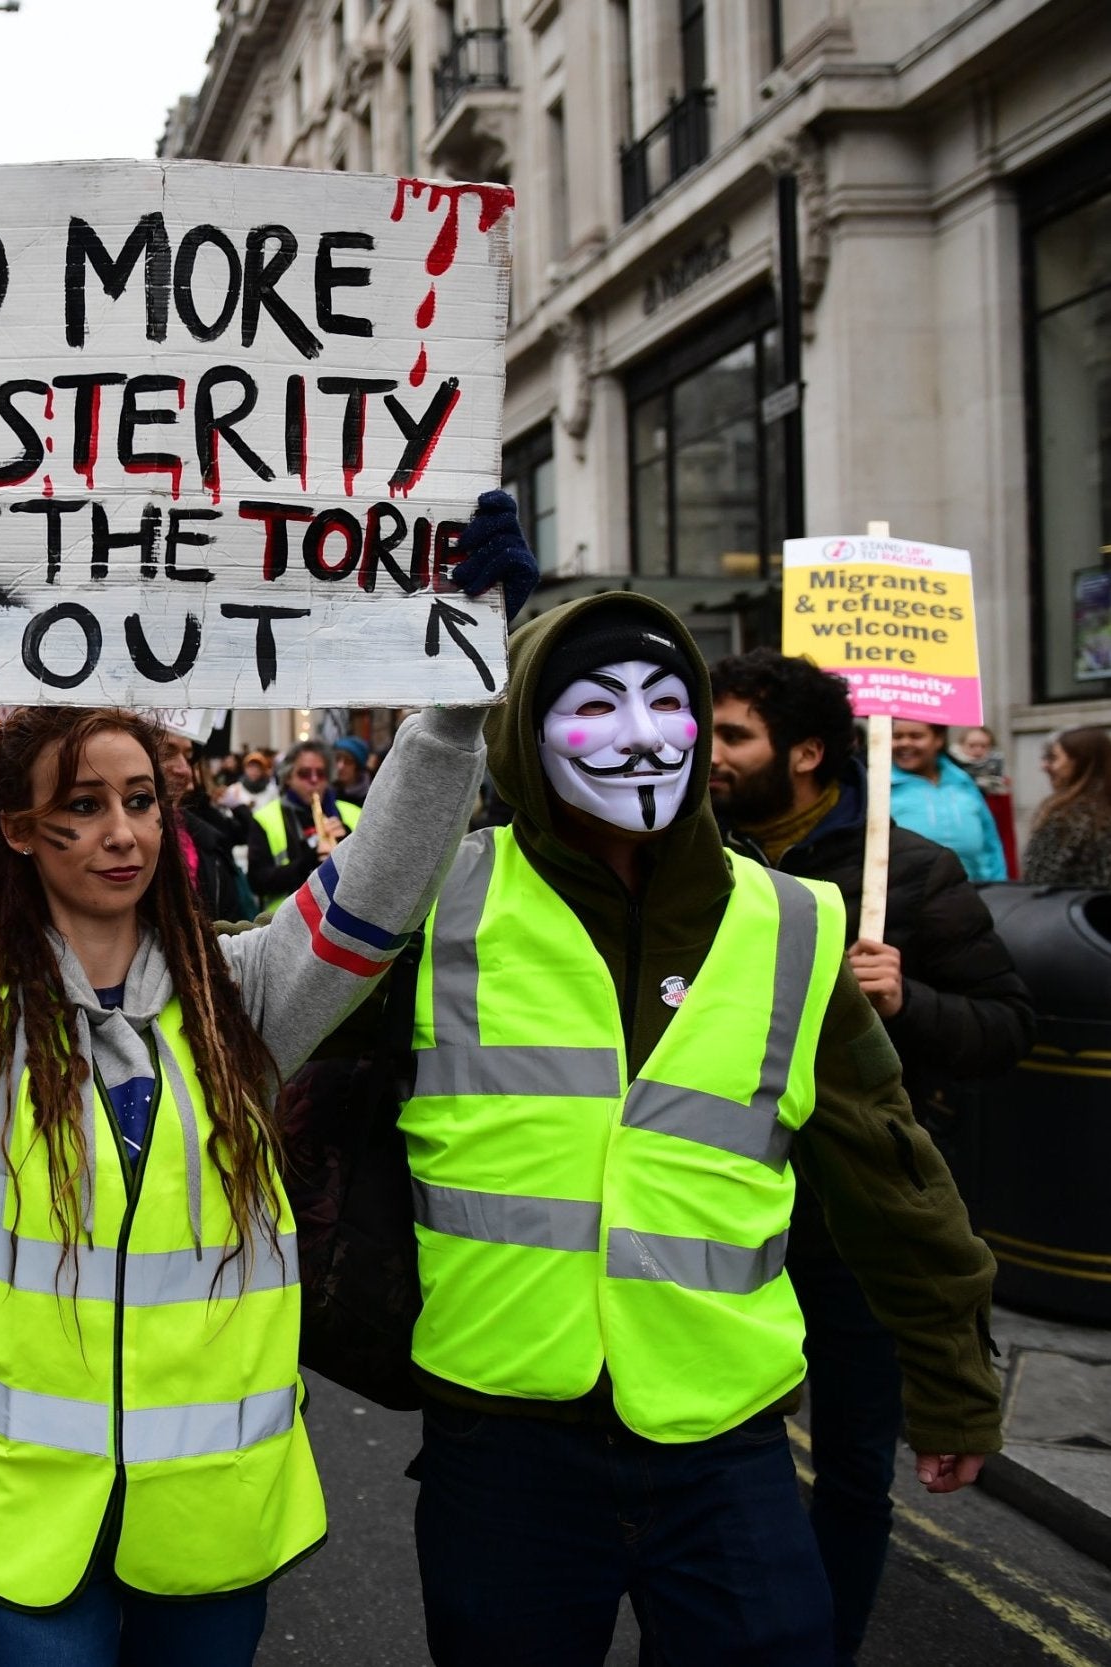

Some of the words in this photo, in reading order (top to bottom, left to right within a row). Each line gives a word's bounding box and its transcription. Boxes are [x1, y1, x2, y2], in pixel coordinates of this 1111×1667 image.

[64, 210, 376, 360] MORE
[10, 498, 222, 584] THE
[238, 500, 471, 595] TORIE
[861, 551, 878, 560] TO
[809, 569, 948, 596] Migrants
[795, 594, 816, 613] &
[826, 593, 964, 621] refugees
[811, 617, 949, 644] welcome
[21, 603, 311, 692] OUT
[844, 641, 917, 664] here
[857, 685, 941, 707] migrants
